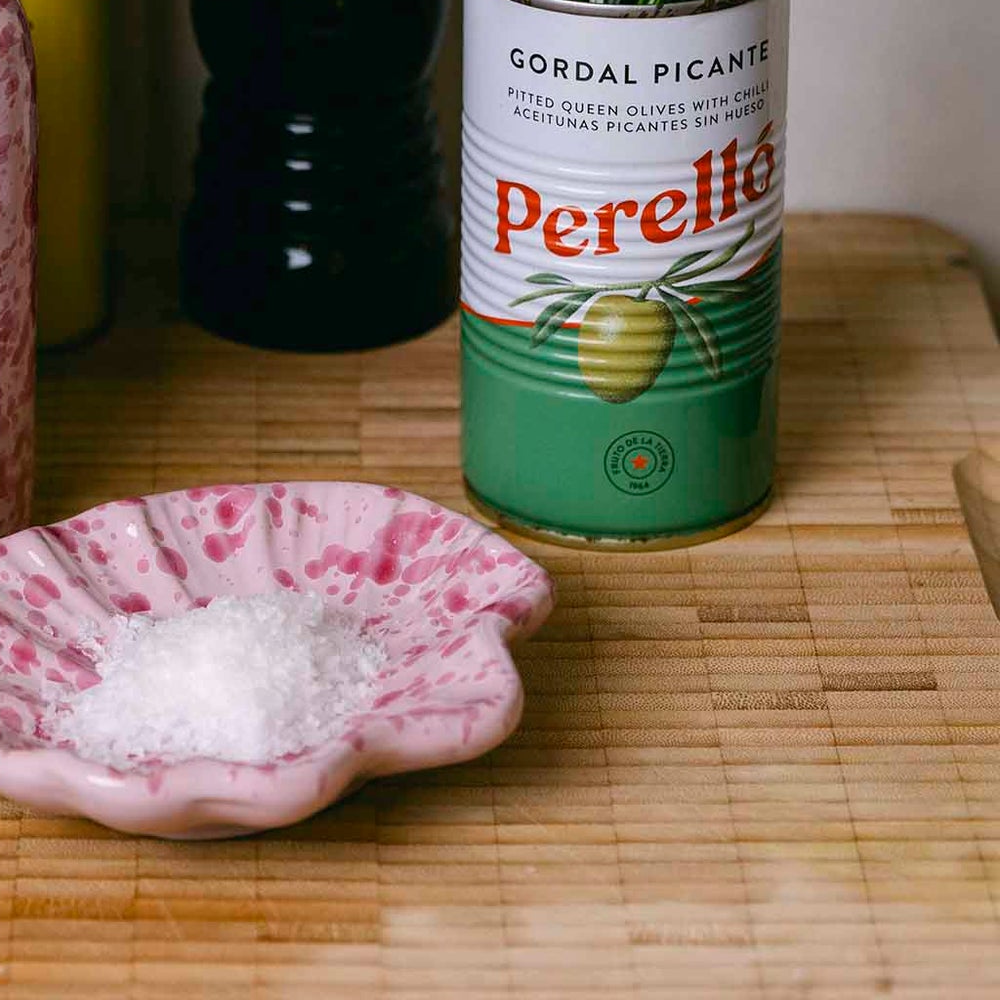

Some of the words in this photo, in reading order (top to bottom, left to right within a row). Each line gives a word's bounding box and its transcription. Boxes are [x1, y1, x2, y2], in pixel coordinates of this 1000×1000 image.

[509, 47, 638, 85] GORDAL
[653, 39, 770, 84] PICANTE
[507, 86, 555, 109] PITTED
[561, 101, 619, 117] QUEEN
[626, 102, 686, 117] OLIVES
[692, 95, 729, 112] WITH
[733, 80, 770, 103] CHILLI
[513, 105, 599, 132] ACEITUNAS
[606, 119, 688, 133] PICANTES
[694, 114, 719, 129] SIN
[724, 98, 765, 122] HUESO
[494, 121, 776, 257] Perelló
